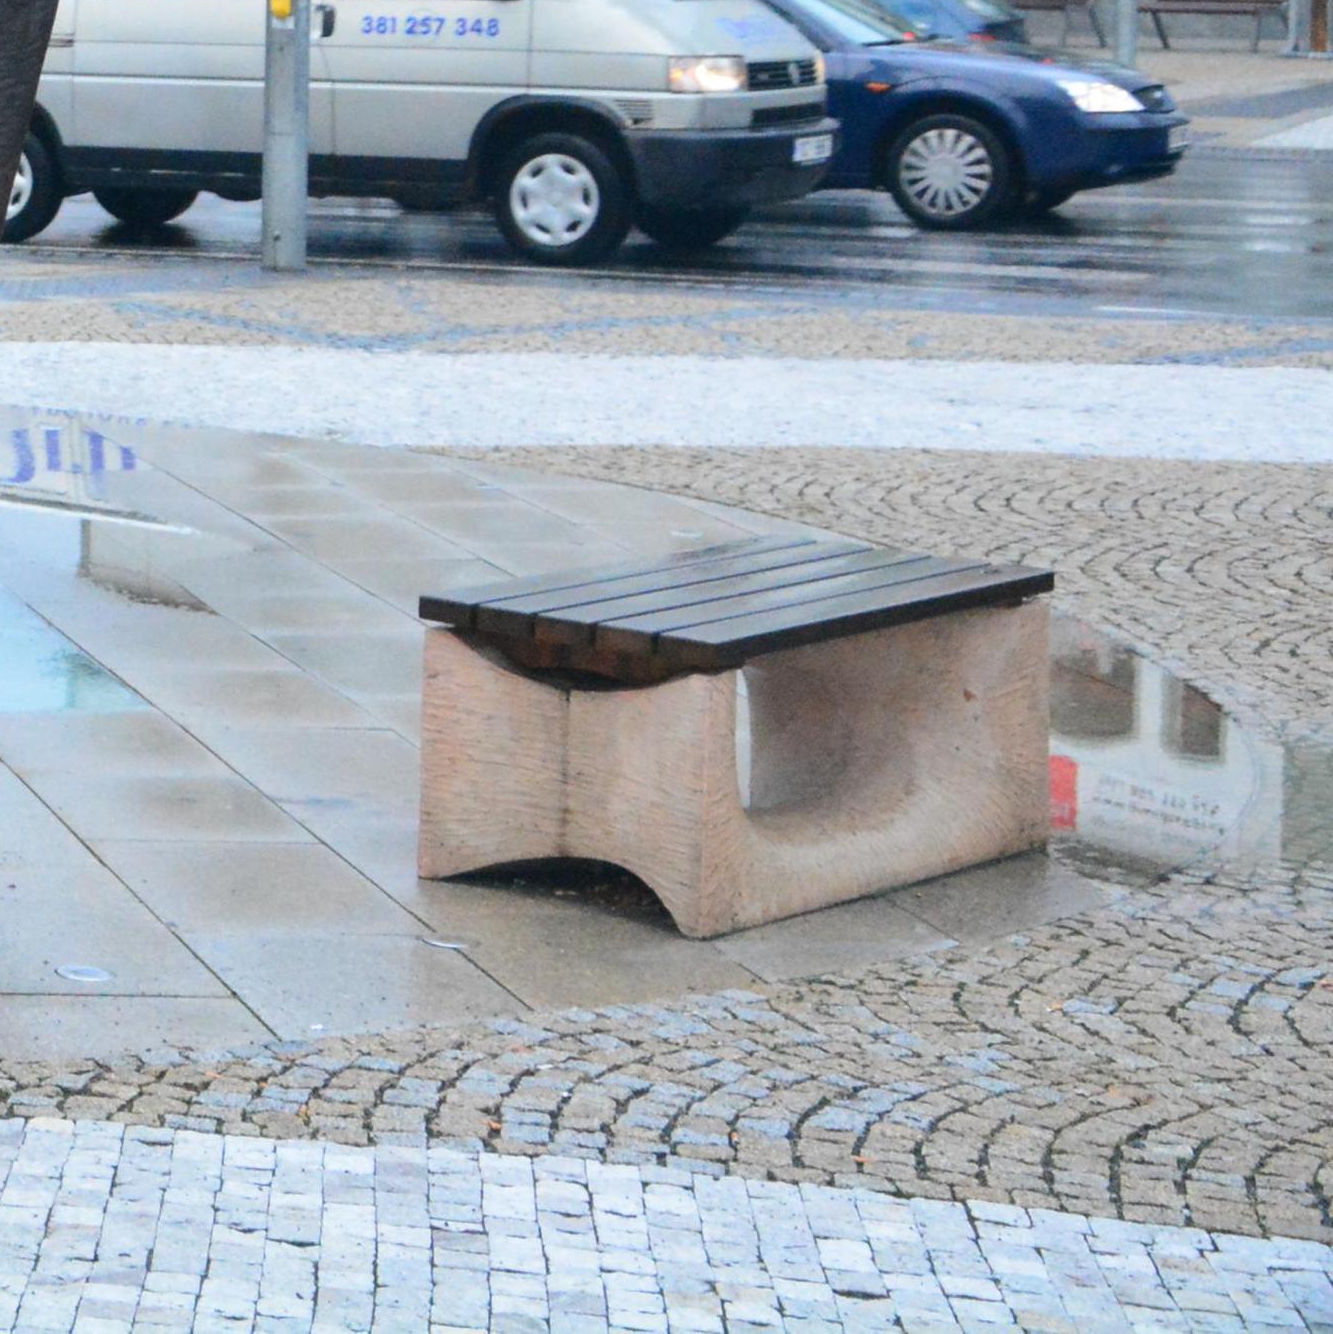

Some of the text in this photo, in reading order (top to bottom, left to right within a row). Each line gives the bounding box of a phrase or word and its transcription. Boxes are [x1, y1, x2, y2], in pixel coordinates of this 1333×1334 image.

[361, 15, 501, 38] 381 257 348
